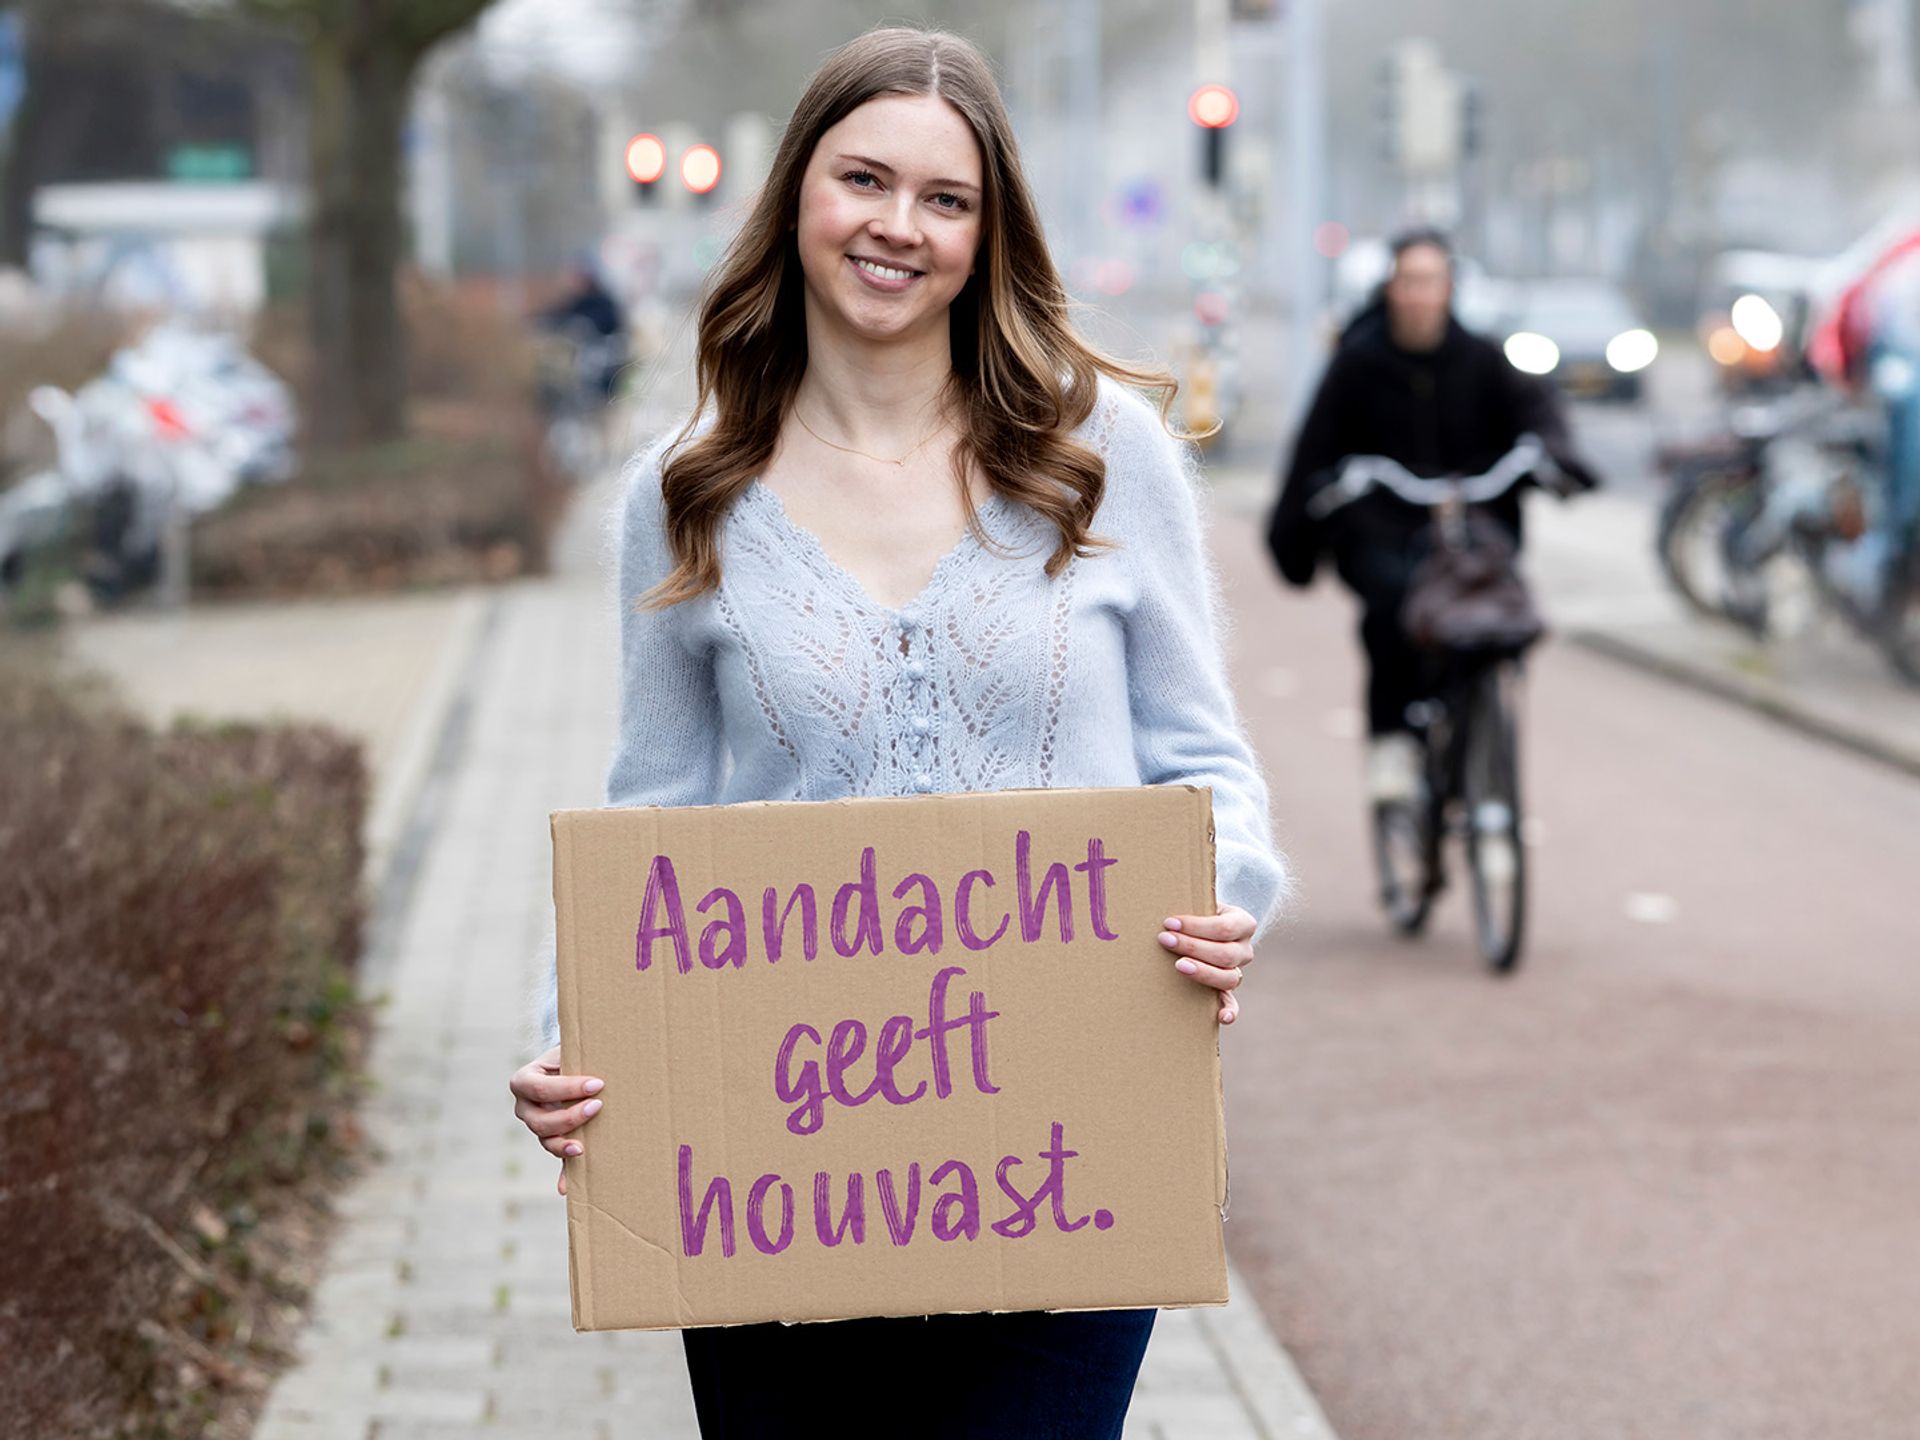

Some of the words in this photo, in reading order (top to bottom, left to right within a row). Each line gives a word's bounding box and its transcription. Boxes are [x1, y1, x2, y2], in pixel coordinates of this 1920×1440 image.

[635, 830, 1119, 975] Aandacht
[774, 966, 1001, 1136] geeft
[677, 1121, 1115, 1258] houvast.
